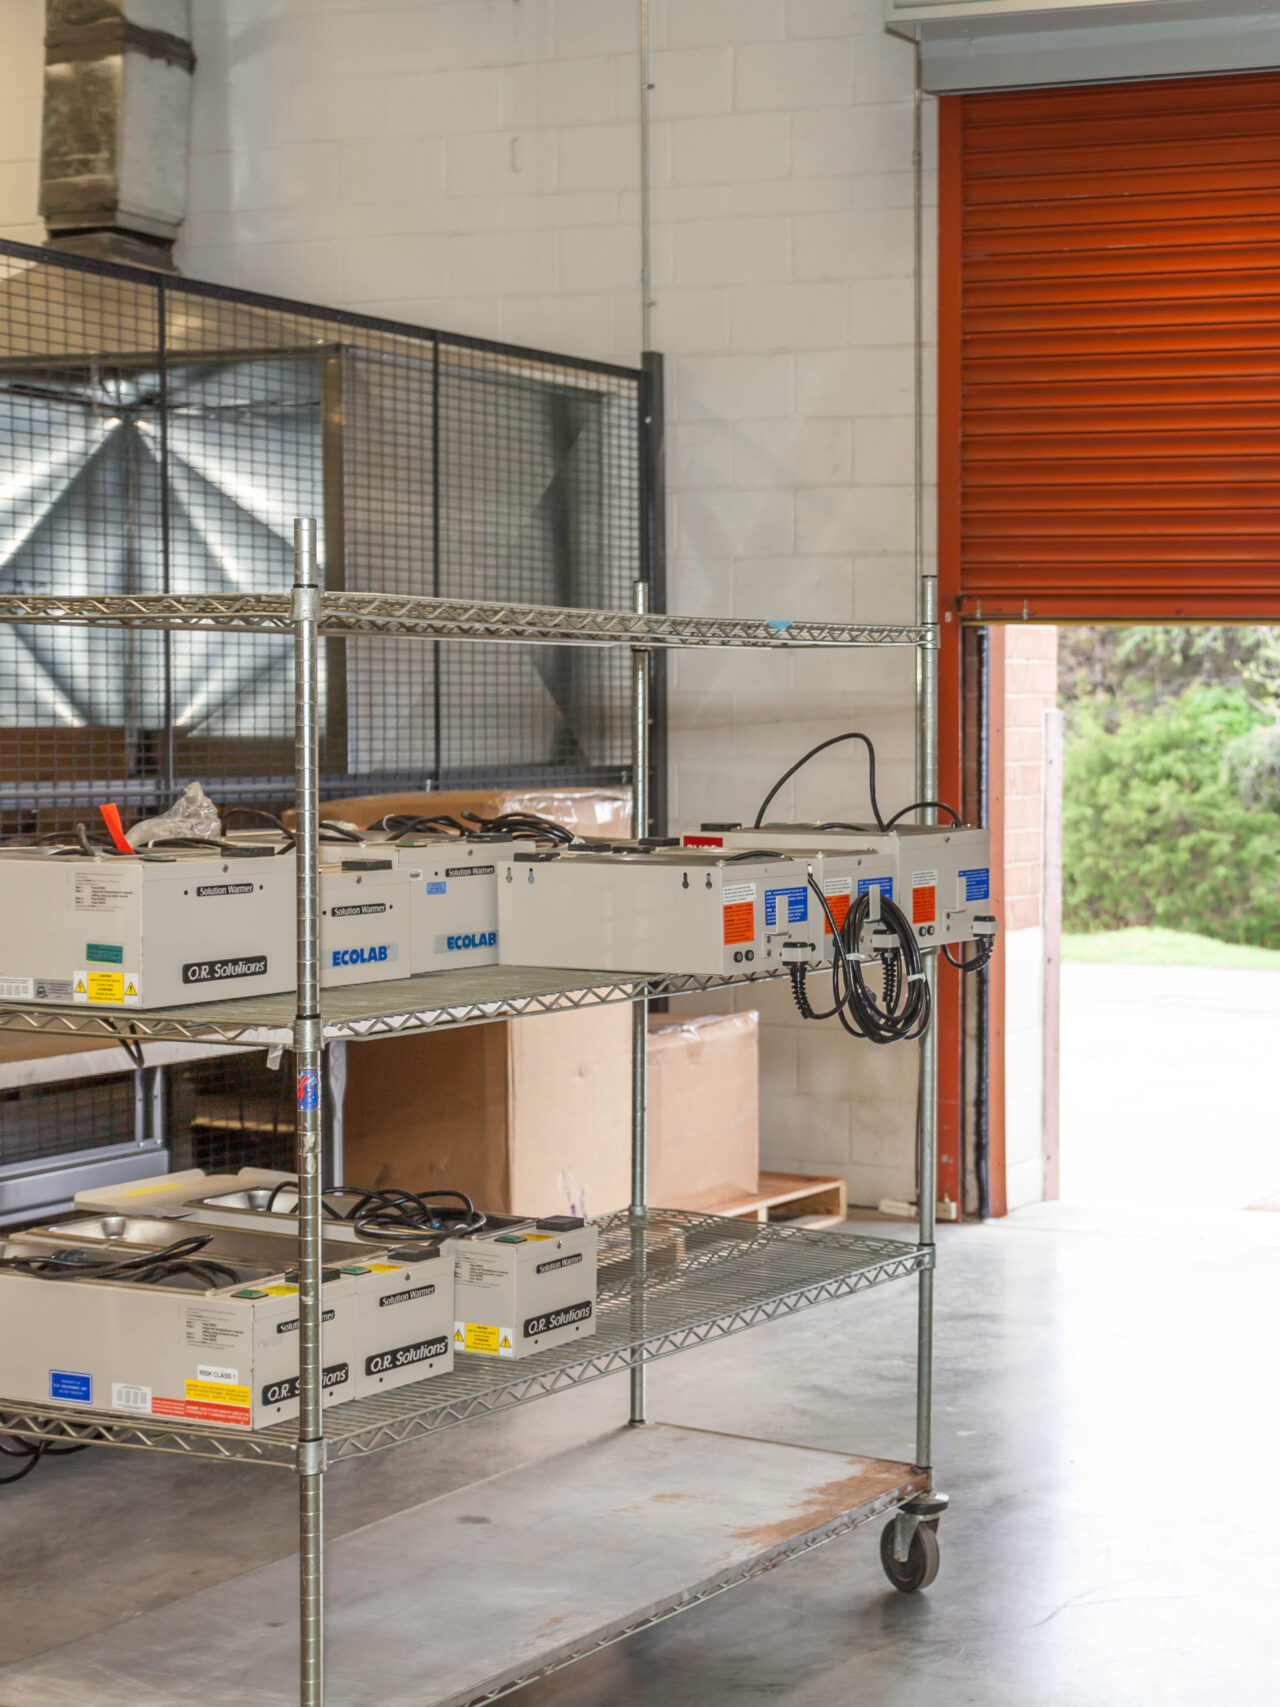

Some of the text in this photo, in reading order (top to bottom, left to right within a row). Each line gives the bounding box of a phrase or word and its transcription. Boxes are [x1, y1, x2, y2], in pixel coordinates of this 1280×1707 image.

[447, 866, 495, 878] Solution Warmer
[200, 884, 253, 896] Solution Warmer
[334, 904, 386, 916] Solution Warmer
[446, 932, 497, 950] ECOLAB
[332, 945, 389, 967] ECOLAB
[188, 959, 266, 981] O.R. Solutions
[540, 1261, 561, 1273] Solution
[382, 1286, 435, 1306] Solution Warmer
[528, 1306, 590, 1334] O.R. Solutions
[370, 1342, 446, 1372] O.R. Solutions
[213, 1371, 232, 1380] CLASS
[267, 1383, 291, 1402] O.R.
